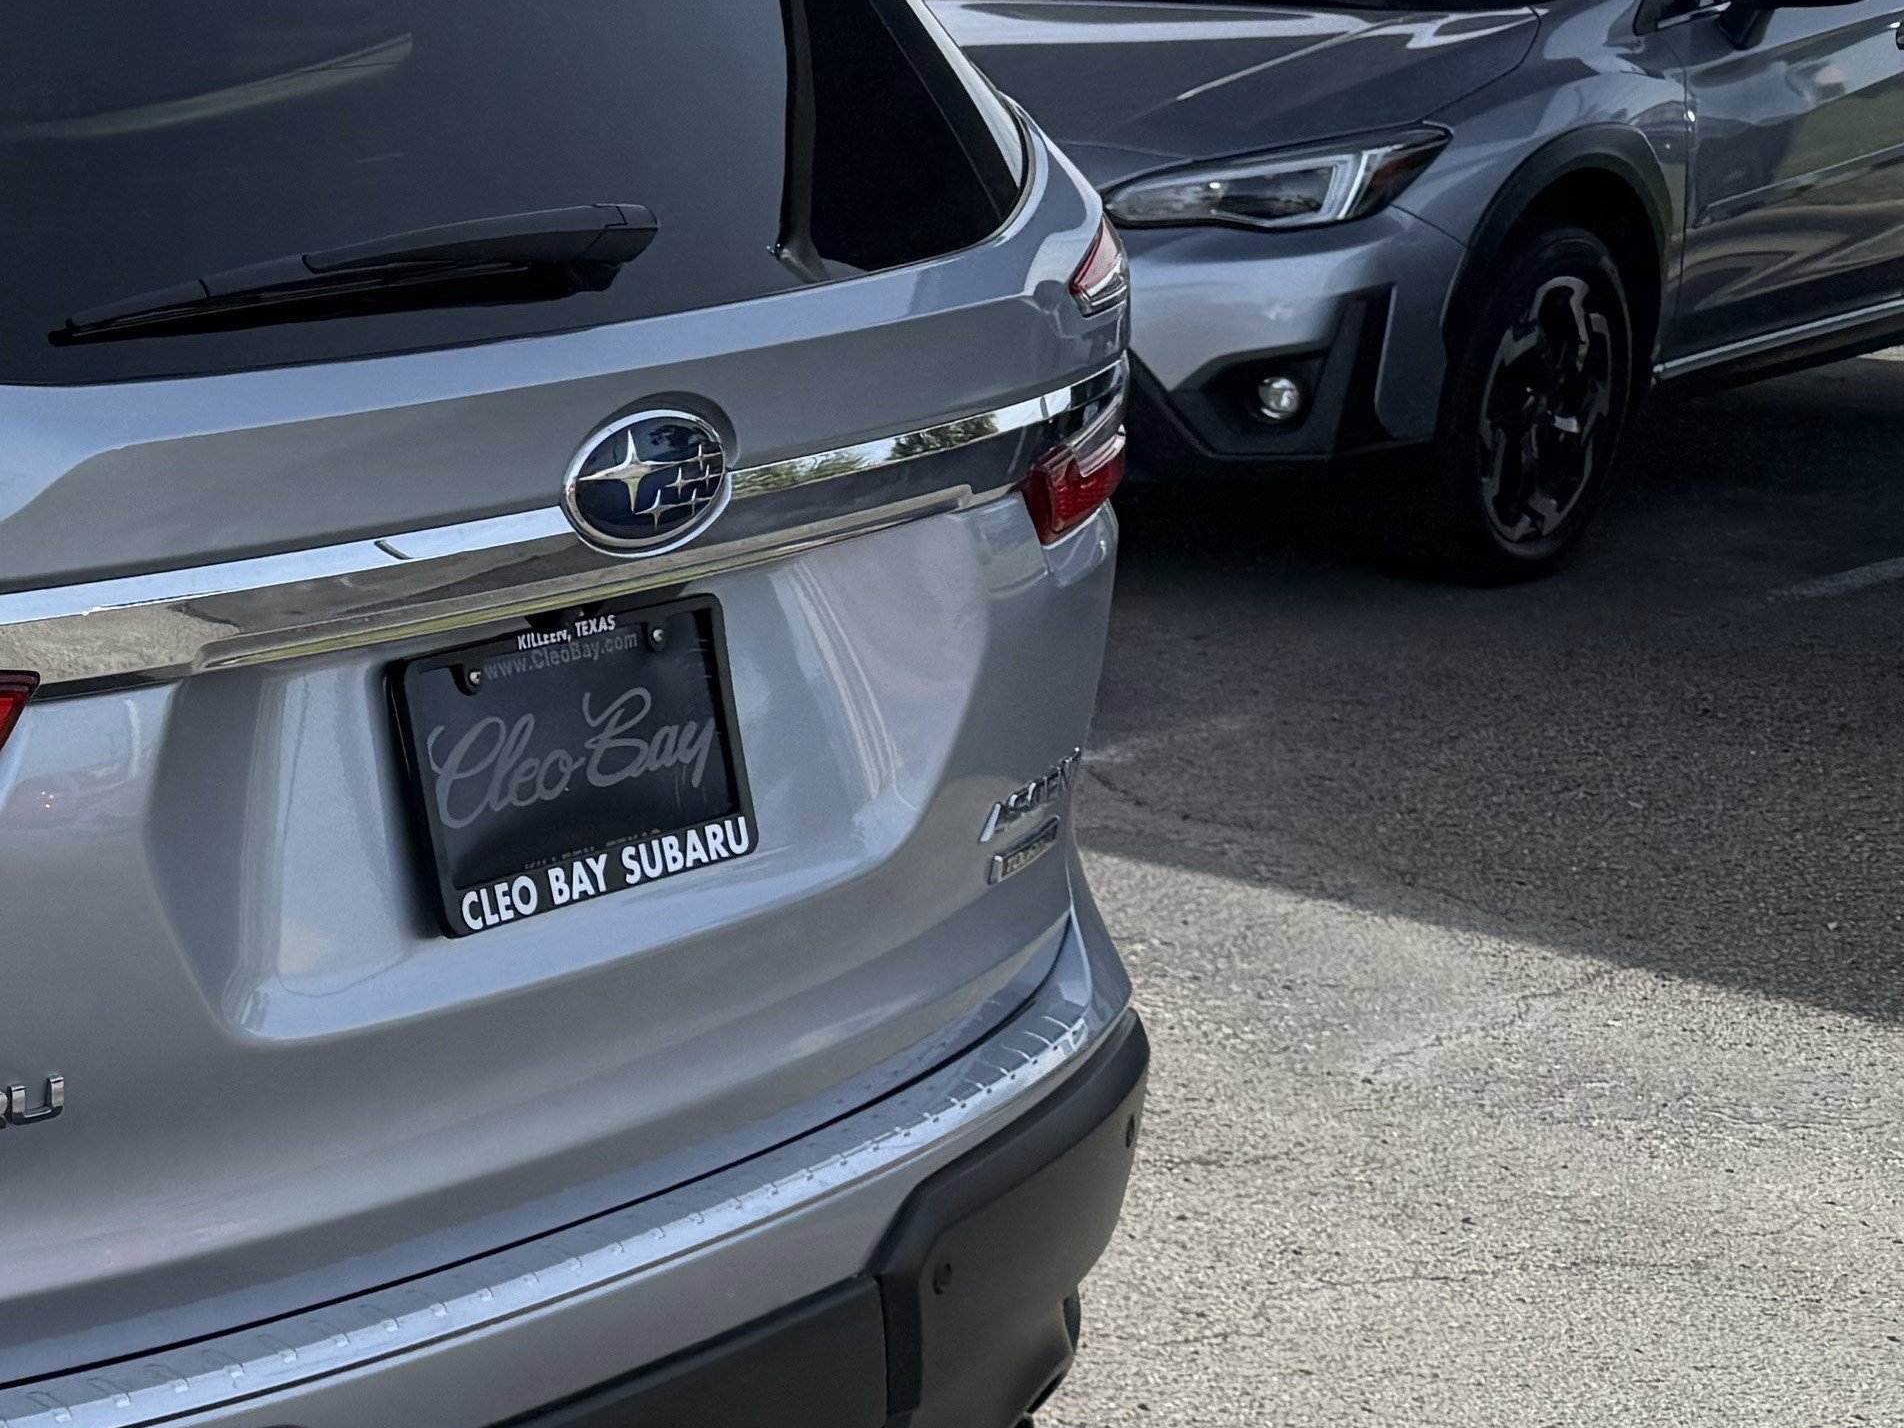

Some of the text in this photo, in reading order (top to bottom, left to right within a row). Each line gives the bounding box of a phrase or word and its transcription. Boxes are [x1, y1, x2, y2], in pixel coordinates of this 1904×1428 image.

[483, 632, 638, 680] www.CleoBay.com
[575, 614, 616, 637] TEXAS
[427, 687, 715, 829] Cleo Bay
[461, 875, 538, 931] CLEO
[547, 853, 607, 906] BAY
[621, 816, 750, 885] SUBARU
